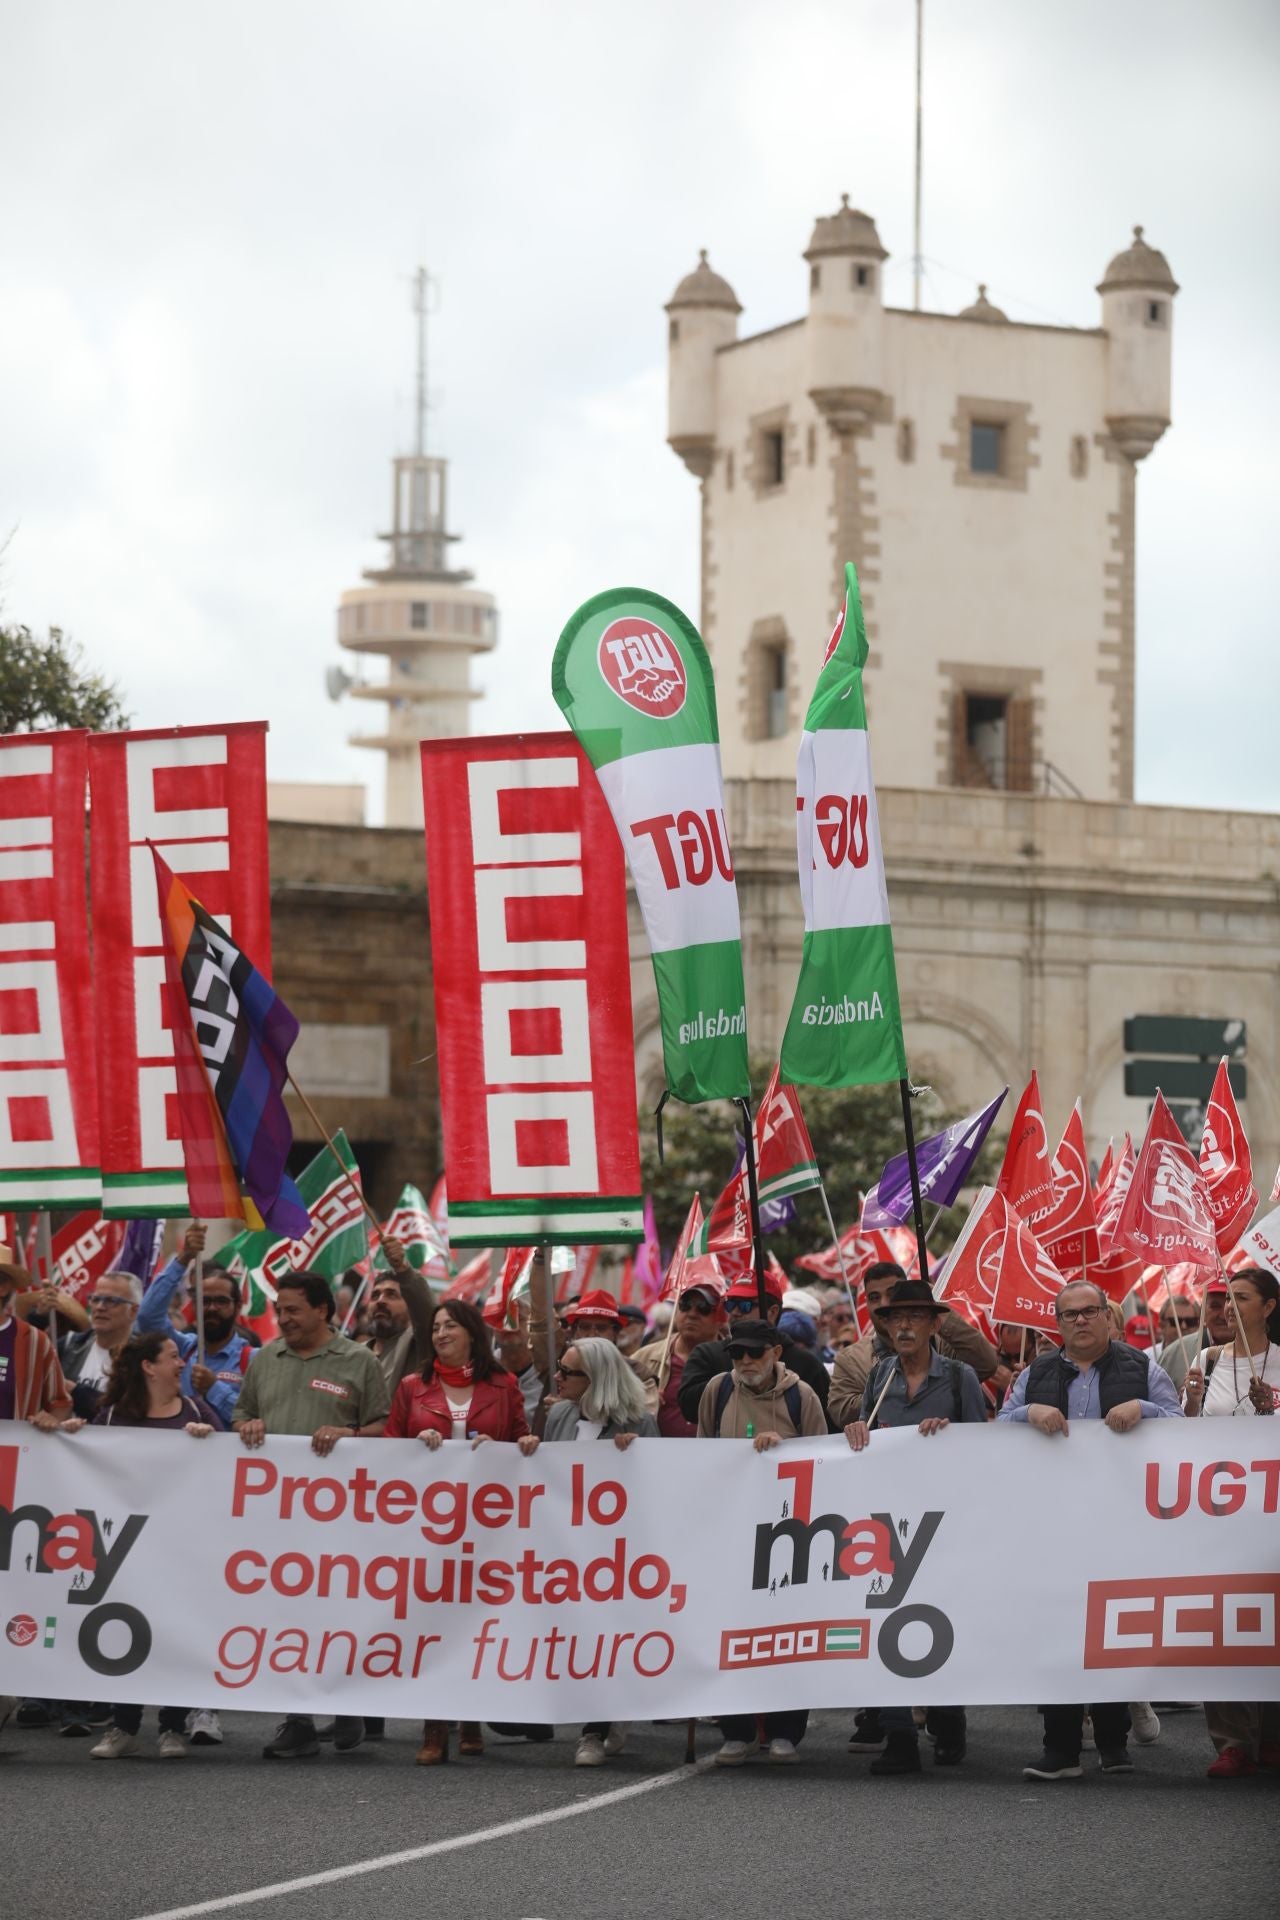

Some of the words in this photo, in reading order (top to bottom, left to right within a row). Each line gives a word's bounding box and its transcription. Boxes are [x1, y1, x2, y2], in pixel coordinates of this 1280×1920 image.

[467, 757, 600, 1195] CCOO
[232, 1457, 545, 1546] Proteger
[571, 1463, 628, 1526] lo
[1145, 1459, 1280, 1520] UGT
[224, 1537, 687, 1619] conquistado,
[214, 1625, 442, 1689] ganar
[471, 1618, 675, 1682] futuro
[727, 1628, 820, 1663] CCOO
